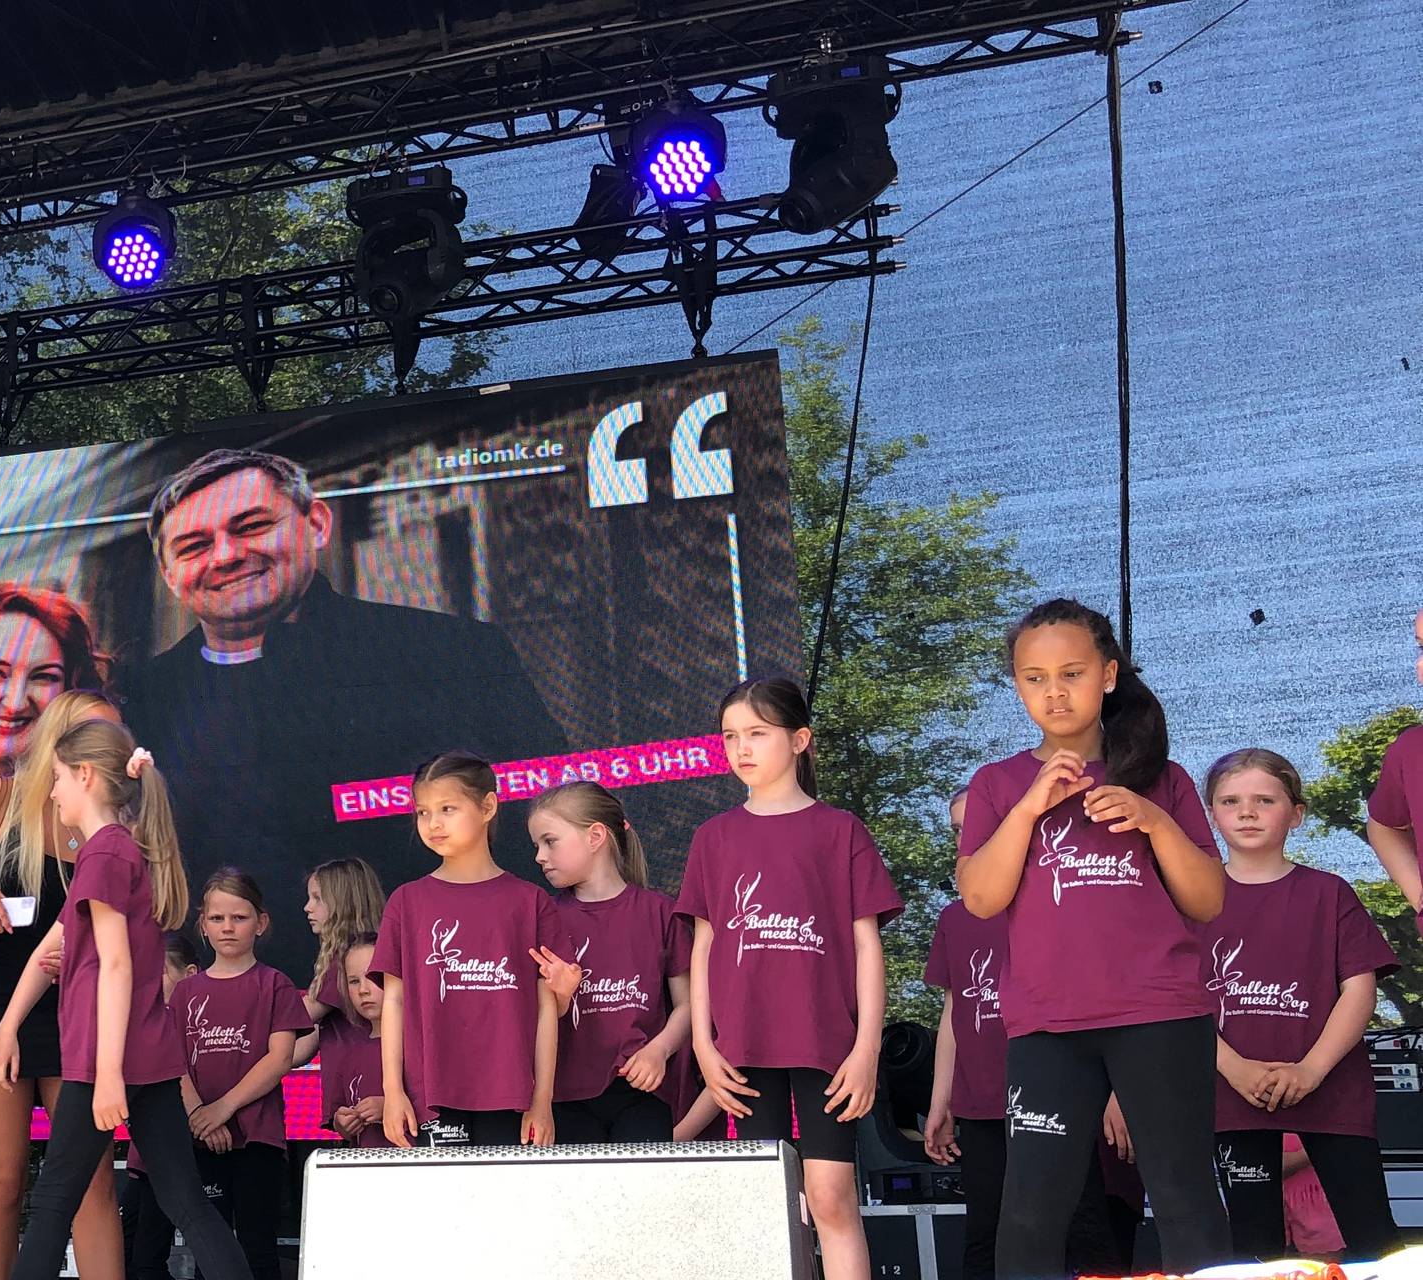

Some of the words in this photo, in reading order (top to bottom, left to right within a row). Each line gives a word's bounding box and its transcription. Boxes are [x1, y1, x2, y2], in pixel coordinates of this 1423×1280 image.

[436, 440, 564, 469] radiomk.de
[611, 757, 630, 779] 6
[639, 746, 710, 776] UHR
[1060, 854, 1118, 868] Ballett
[1078, 866, 1117, 877] meets
[745, 913, 799, 930] Ballett
[760, 928, 797, 939] meets
[799, 915, 824, 947] Pop
[445, 959, 495, 972] Ballett
[461, 972, 493, 982] meets
[494, 956, 516, 983] Pop
[579, 978, 625, 995] Ballett
[592, 991, 624, 1002] meets
[626, 974, 649, 1004] Pop
[1225, 981, 1280, 996] Ballett
[1239, 995, 1278, 1005] meets
[1279, 981, 1309, 1012] Pop
[198, 1026, 234, 1039] Ballett
[205, 1036, 232, 1046] meets
